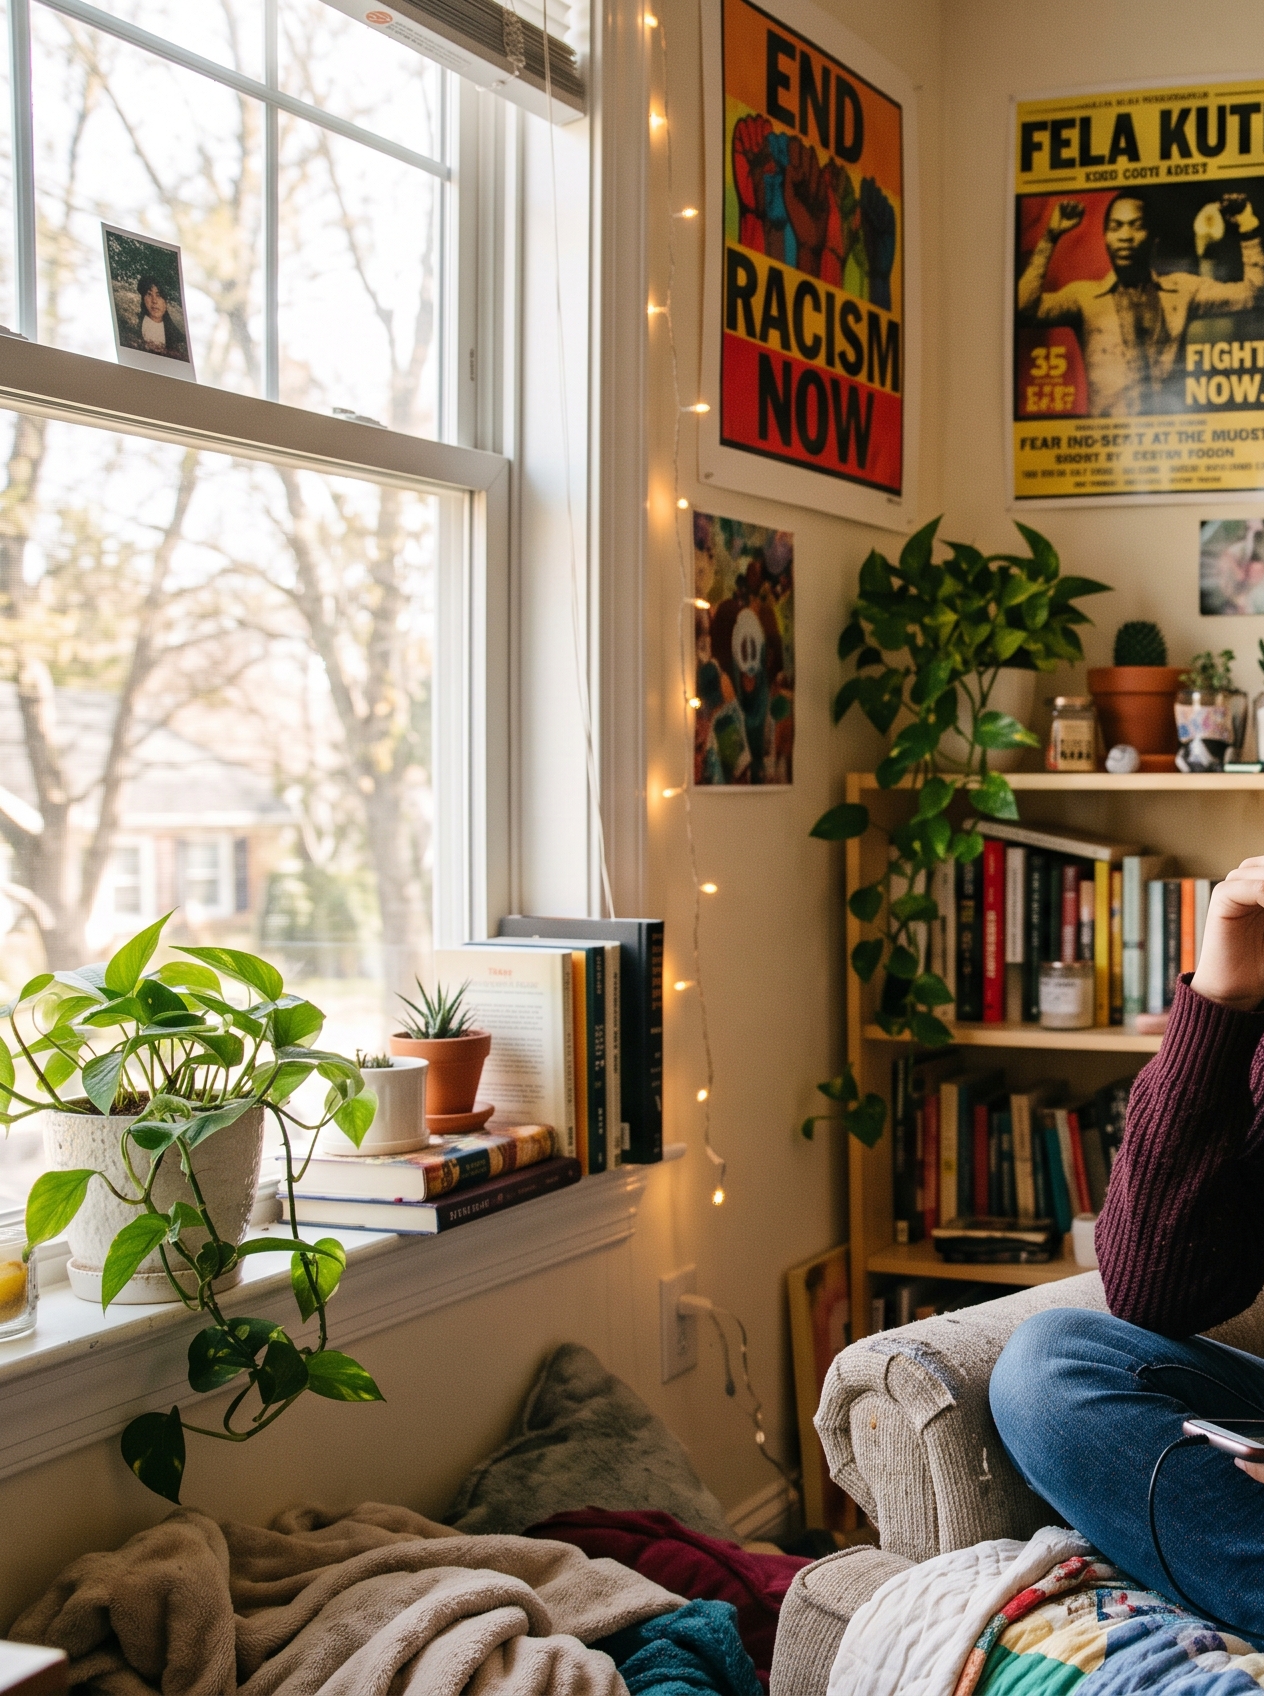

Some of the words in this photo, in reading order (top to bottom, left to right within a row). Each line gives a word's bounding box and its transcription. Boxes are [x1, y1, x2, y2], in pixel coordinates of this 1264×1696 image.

[766, 28, 864, 164] END
[1020, 113, 1141, 173] FELA
[726, 246, 900, 393] RACISM
[1030, 346, 1067, 377] 35
[758, 352, 875, 470] NOW
